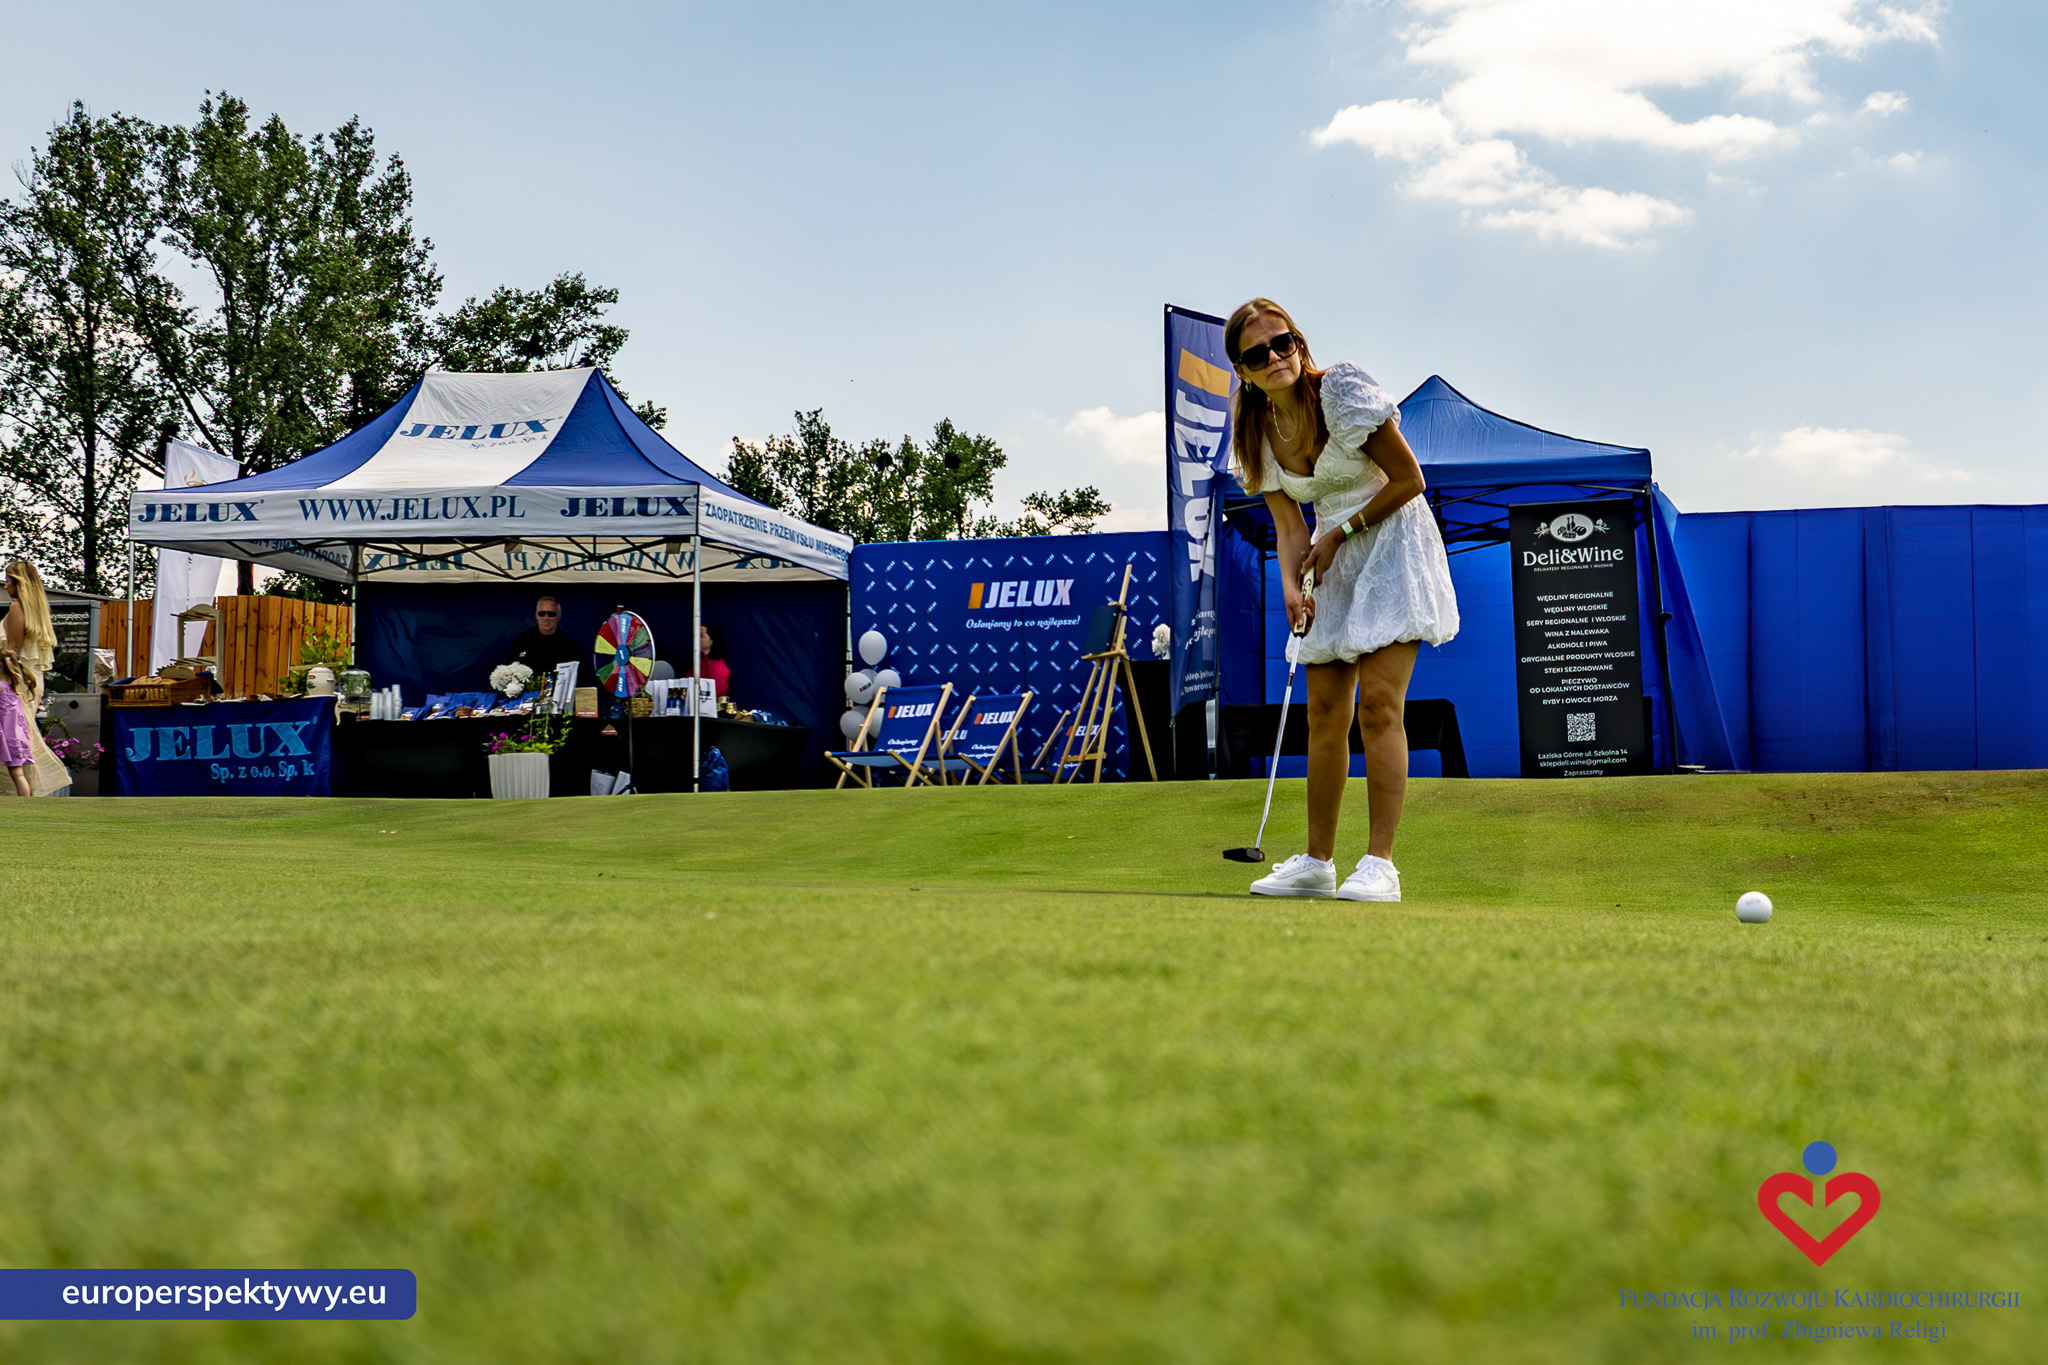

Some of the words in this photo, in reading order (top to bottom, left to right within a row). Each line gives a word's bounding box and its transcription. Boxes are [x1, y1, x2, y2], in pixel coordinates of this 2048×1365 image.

[400, 418, 556, 441] JELUX
[1174, 388, 1227, 583] JELUX
[138, 502, 259, 522] JELUX
[299, 496, 526, 521] WWW.JELUX.PL
[560, 496, 692, 517] JELUX
[706, 503, 768, 534] ZAOPATRZENIE
[1523, 546, 1624, 567] Deli&Wine
[985, 579, 1074, 609] JELUX
[1536, 594, 1568, 602] WĘDLINY
[1569, 591, 1613, 599] REGIONALNE
[1543, 606, 1575, 614] WĘDLINY
[1577, 603, 1608, 611] WŁOSKIE
[1037, 615, 1080, 630] najlepsze!
[1544, 617, 1588, 625] REGIONALNE
[1595, 614, 1626, 623] WŁOSKIE
[1571, 628, 1609, 636] NALEWAKA
[1547, 641, 1584, 649] ALKOHOLE
[1521, 654, 1564, 663] ORYGINALNE
[1564, 664, 1613, 673] SEZONOWANE
[1541, 685, 1582, 693] LOKALNYCH
[1583, 682, 1630, 691] DOSTAWCÓW
[1561, 677, 1597, 685] PIECZYWO
[895, 703, 934, 718] JELUX
[980, 711, 1016, 724] JELUX
[125, 723, 312, 761] JELUX
[210, 763, 234, 783] Sp.
[238, 766, 247, 778] z
[250, 766, 275, 778] o.o.
[279, 760, 298, 781] Sp.
[302, 759, 315, 775] k
[1563, 769, 1604, 777] Zapraszamy
